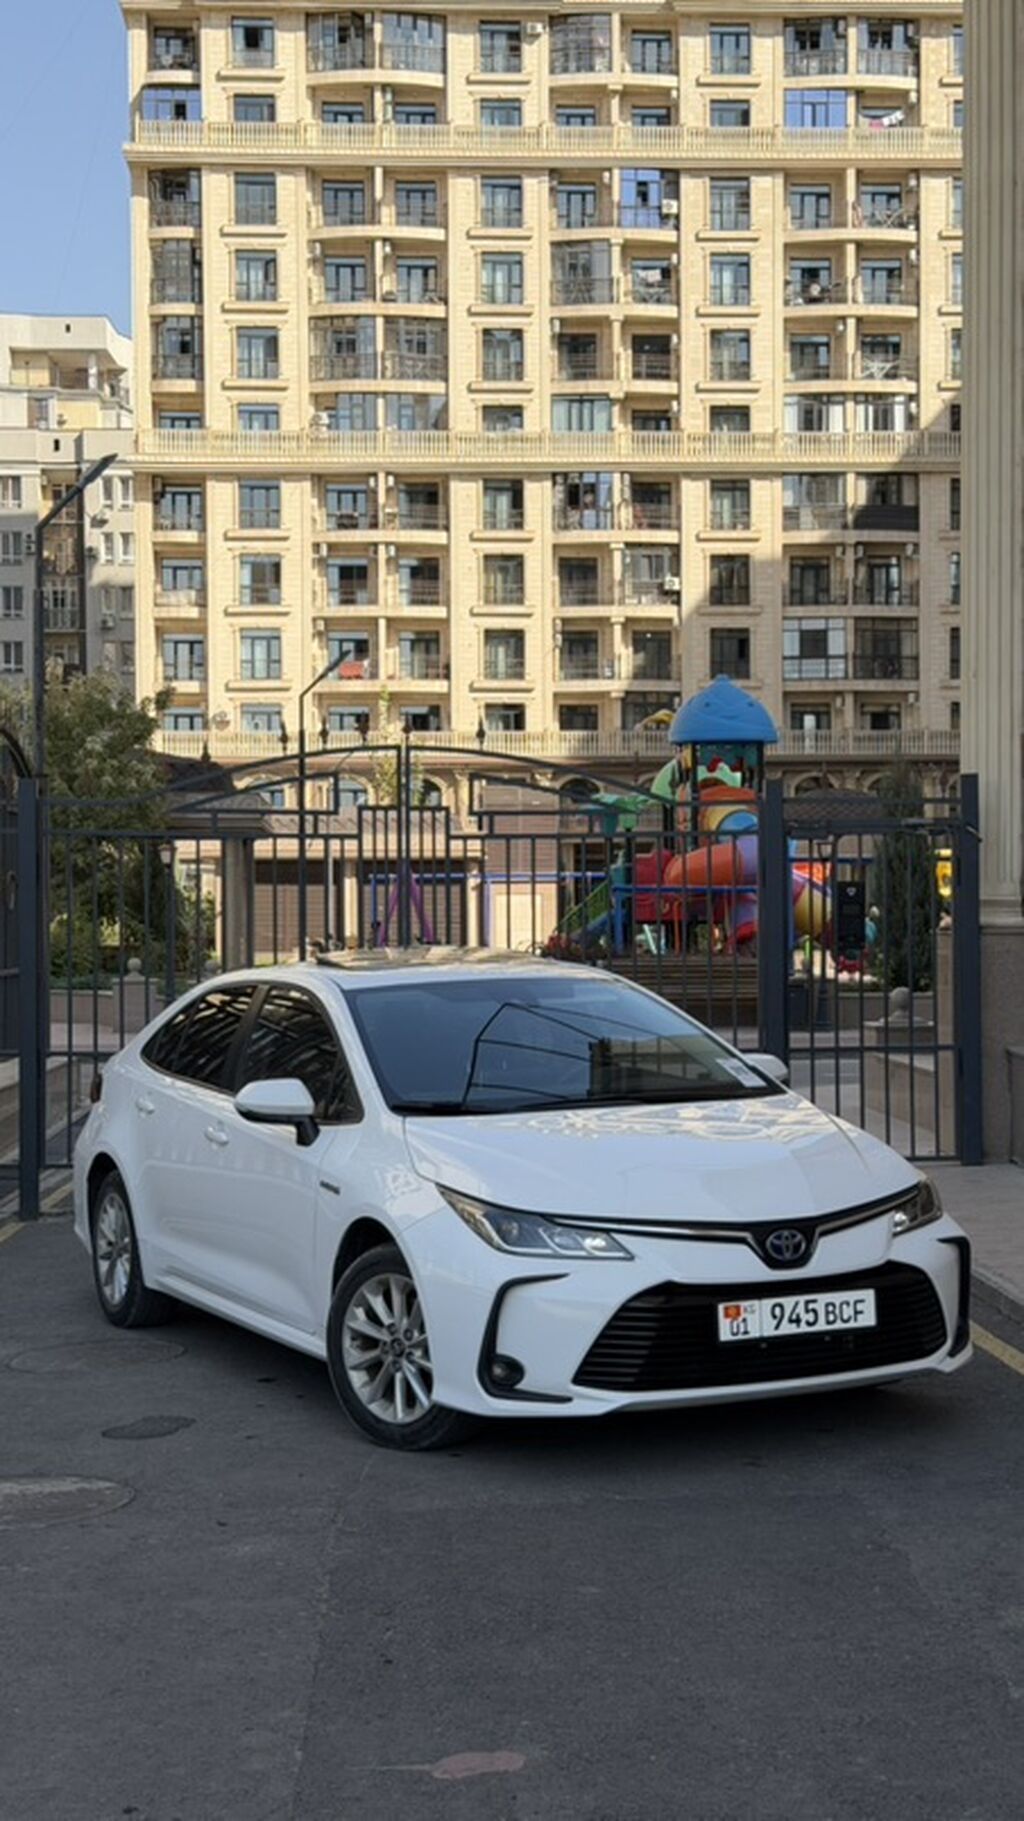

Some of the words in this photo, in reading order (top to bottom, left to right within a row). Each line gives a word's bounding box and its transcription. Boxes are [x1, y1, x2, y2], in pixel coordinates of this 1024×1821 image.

[730, 1317, 750, 1337] 01
[770, 1299, 819, 1331] 945
[824, 1299, 866, 1326] BCF
